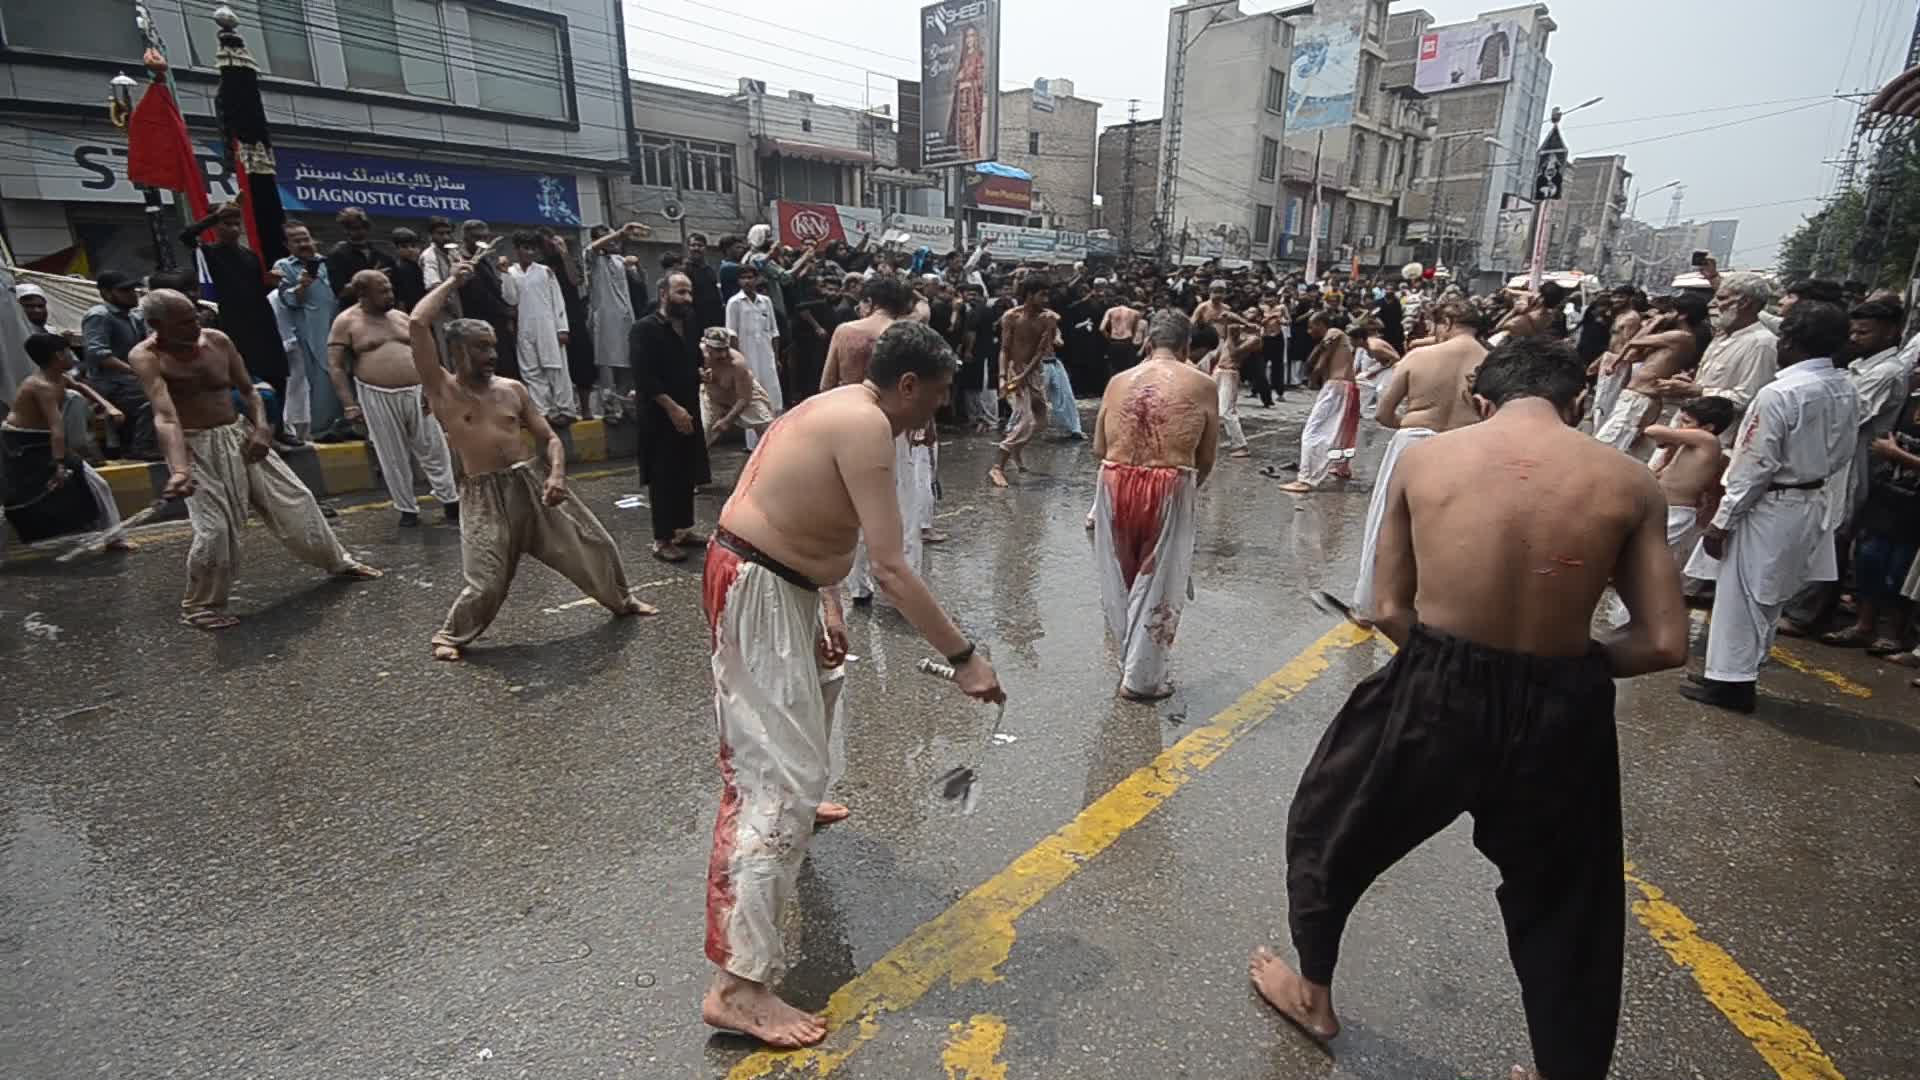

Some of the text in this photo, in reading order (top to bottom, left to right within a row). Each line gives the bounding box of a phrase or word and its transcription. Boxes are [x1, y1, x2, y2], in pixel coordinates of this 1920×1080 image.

[74, 145, 237, 197] SR
[296, 186, 471, 211] DIAGNOSTIC CENTER
